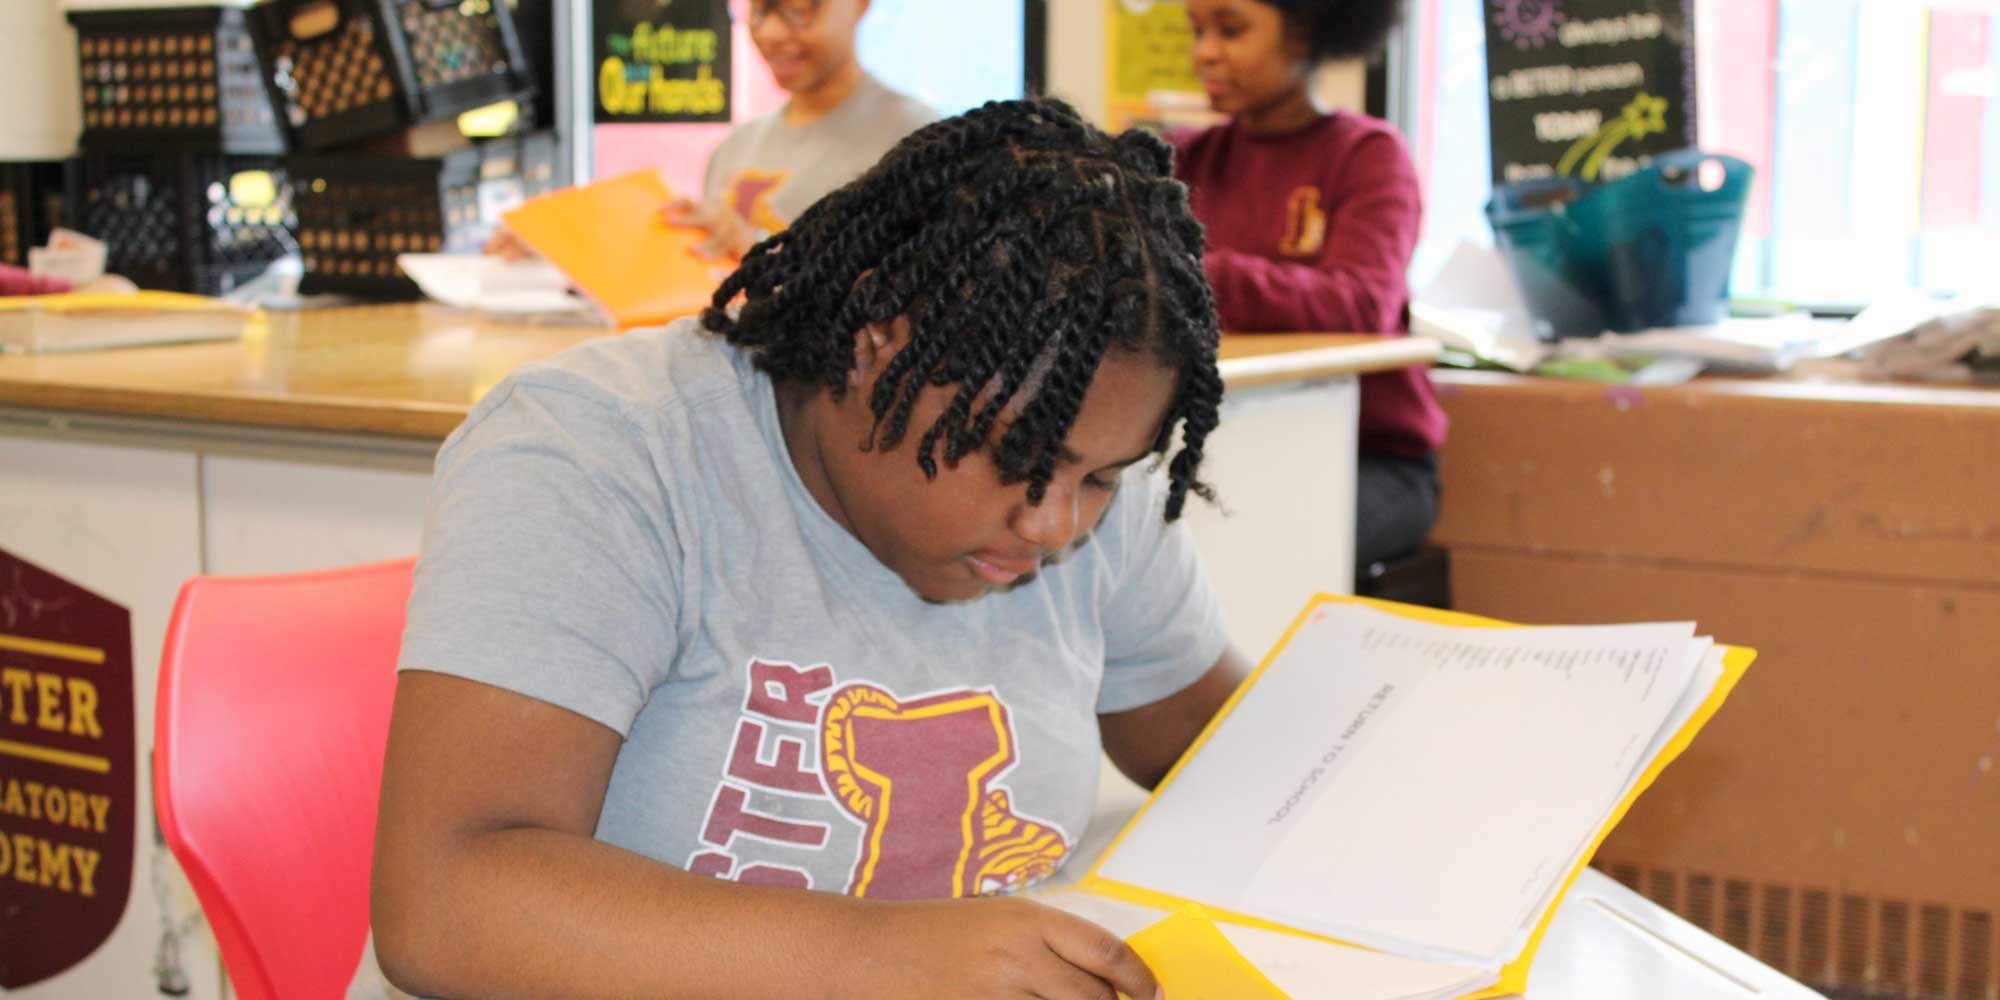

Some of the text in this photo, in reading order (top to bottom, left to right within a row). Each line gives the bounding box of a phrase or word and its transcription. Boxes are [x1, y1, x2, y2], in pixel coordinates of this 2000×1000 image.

[0, 667, 103, 738] TER
[1266, 682, 1395, 825] RETURN TO SCHOOL
[0, 779, 111, 833] ATORY
